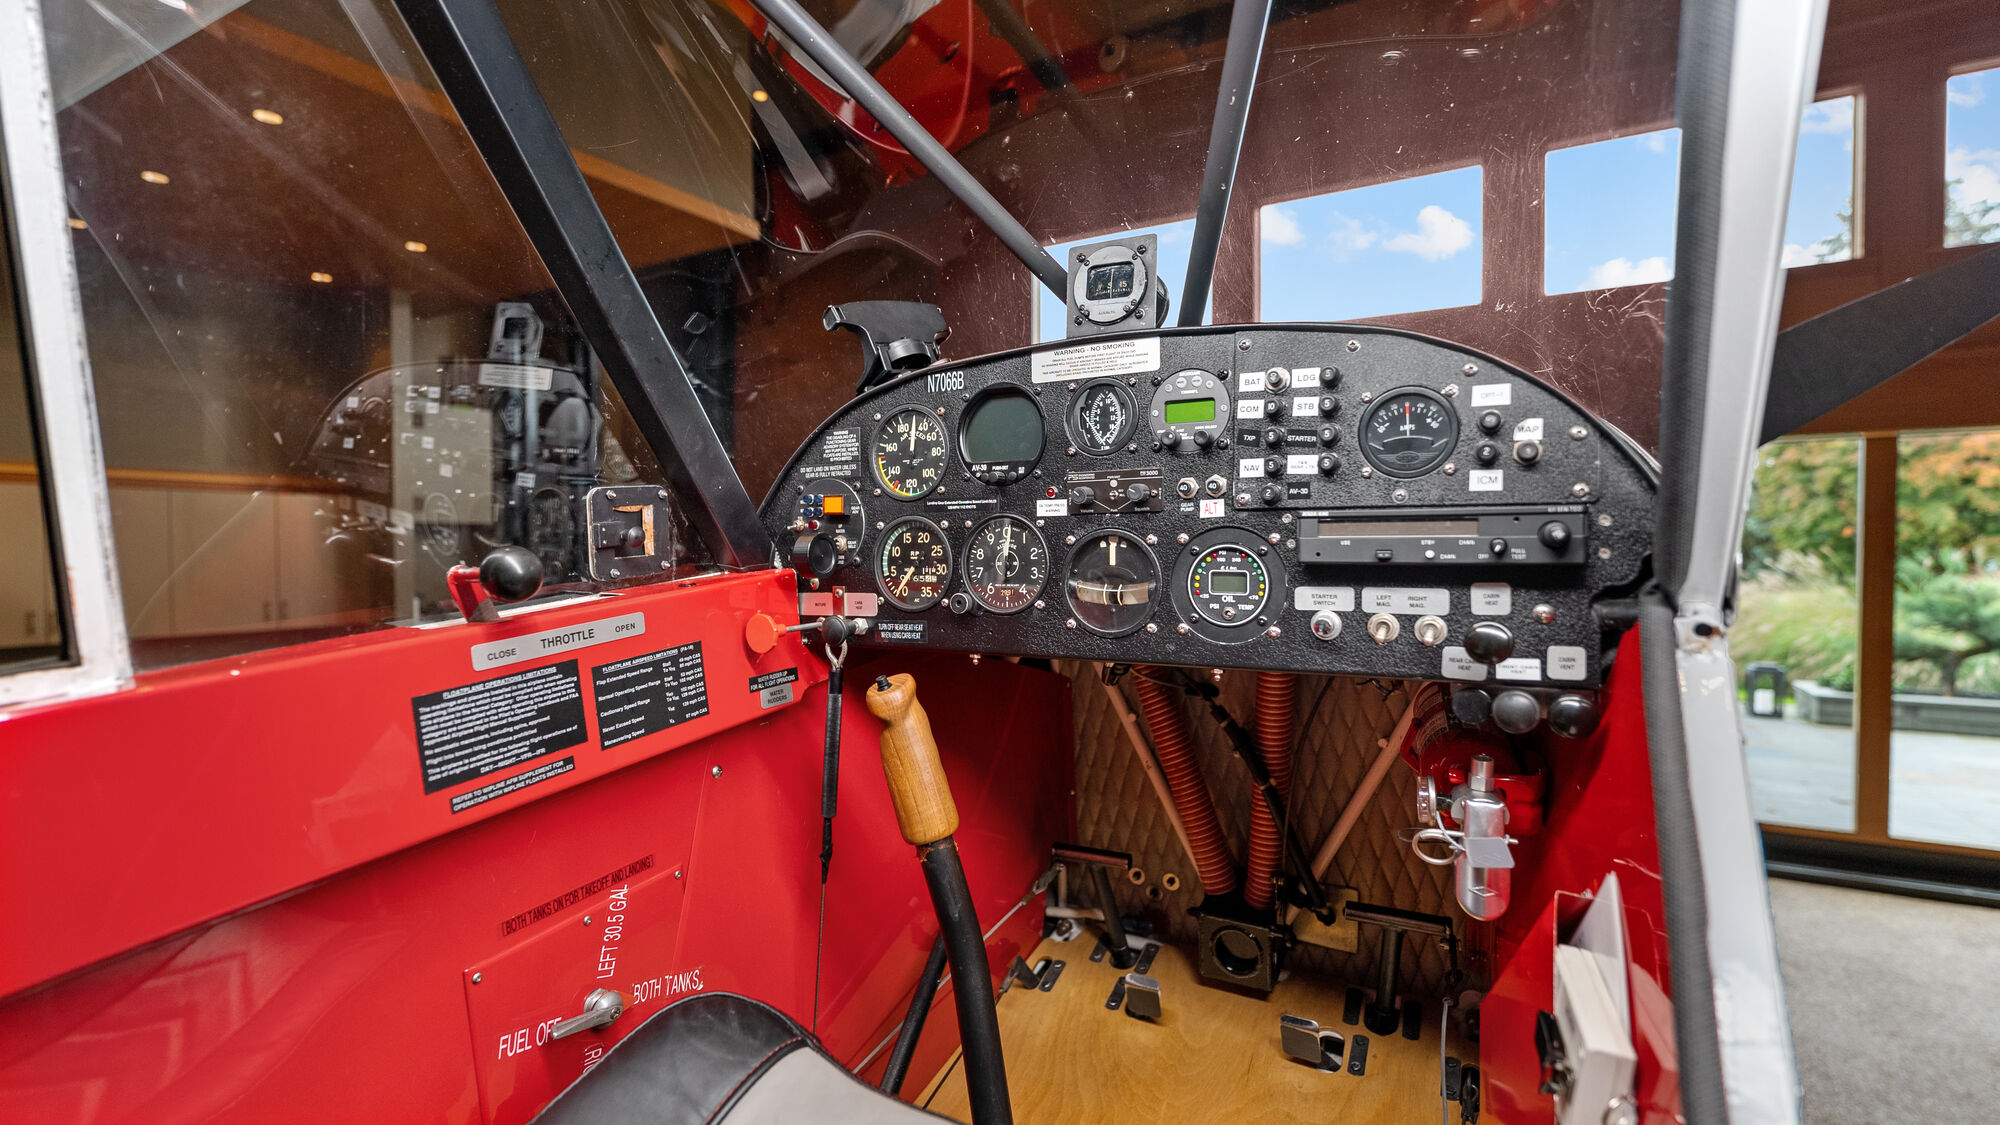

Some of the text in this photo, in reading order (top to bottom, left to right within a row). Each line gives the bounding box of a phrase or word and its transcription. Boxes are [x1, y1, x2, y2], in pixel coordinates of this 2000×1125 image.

[1054, 348, 1085, 356] WARNING
[1103, 342, 1135, 350] SMOKING
[928, 371, 964, 392] N7066B
[1240, 405, 1259, 413] COM
[898, 424, 909, 432] 180
[918, 422, 928, 431] 40
[1517, 425, 1539, 433] MAP
[927, 432, 936, 441] 60
[886, 443, 897, 452] 160
[932, 447, 941, 456] 80
[1483, 447, 1490, 455] 2
[889, 466, 900, 474] 140
[923, 469, 935, 477] 100
[906, 479, 917, 487] 120
[1477, 476, 1498, 484] ICM
[1204, 502, 1218, 514] ALT
[904, 533, 912, 543] 15
[918, 533, 930, 543] 20
[987, 533, 994, 544] 9
[1023, 532, 1025, 544] 1
[892, 547, 900, 557] 10
[931, 545, 943, 556] 25
[977, 549, 984, 559] 8
[1031, 548, 1038, 559] 2
[891, 566, 896, 576] 5
[936, 564, 947, 575] 30
[976, 567, 983, 578] 7
[1031, 567, 1038, 578] 3
[902, 586, 908, 596] 0
[921, 587, 932, 597] 35
[987, 583, 994, 594] 6
[1019, 584, 1027, 594] 4
[615, 622, 636, 633] OPEN
[540, 628, 595, 649] THROTTLE
[487, 647, 517, 661] CLOSE
[632, 655, 654, 665] AIRSPEED
[653, 648, 678, 660] LIMITATIONS
[607, 673, 626, 683] Extended
[627, 670, 640, 678] Speed
[640, 666, 653, 675] Range
[615, 687, 635, 698] Operating
[635, 683, 648, 691] Speed
[648, 679, 661, 688] Range
[600, 698, 651, 718] Cautionary Speed Range
[602, 715, 645, 733] Never Exceed Speed
[604, 728, 645, 747] Maneuvering Speed
[553, 761, 563, 769] FOR
[526, 774, 546, 785] FLOATS
[547, 764, 573, 777] INSTALLED
[506, 857, 651, 934] BOTH TANKS ON FOR TAKEOFF AND LANDING
[597, 884, 628, 979] LEFT 30.5 GAL
[633, 969, 700, 1005] BOTH TANKS
[498, 1028, 532, 1060] FUEL
